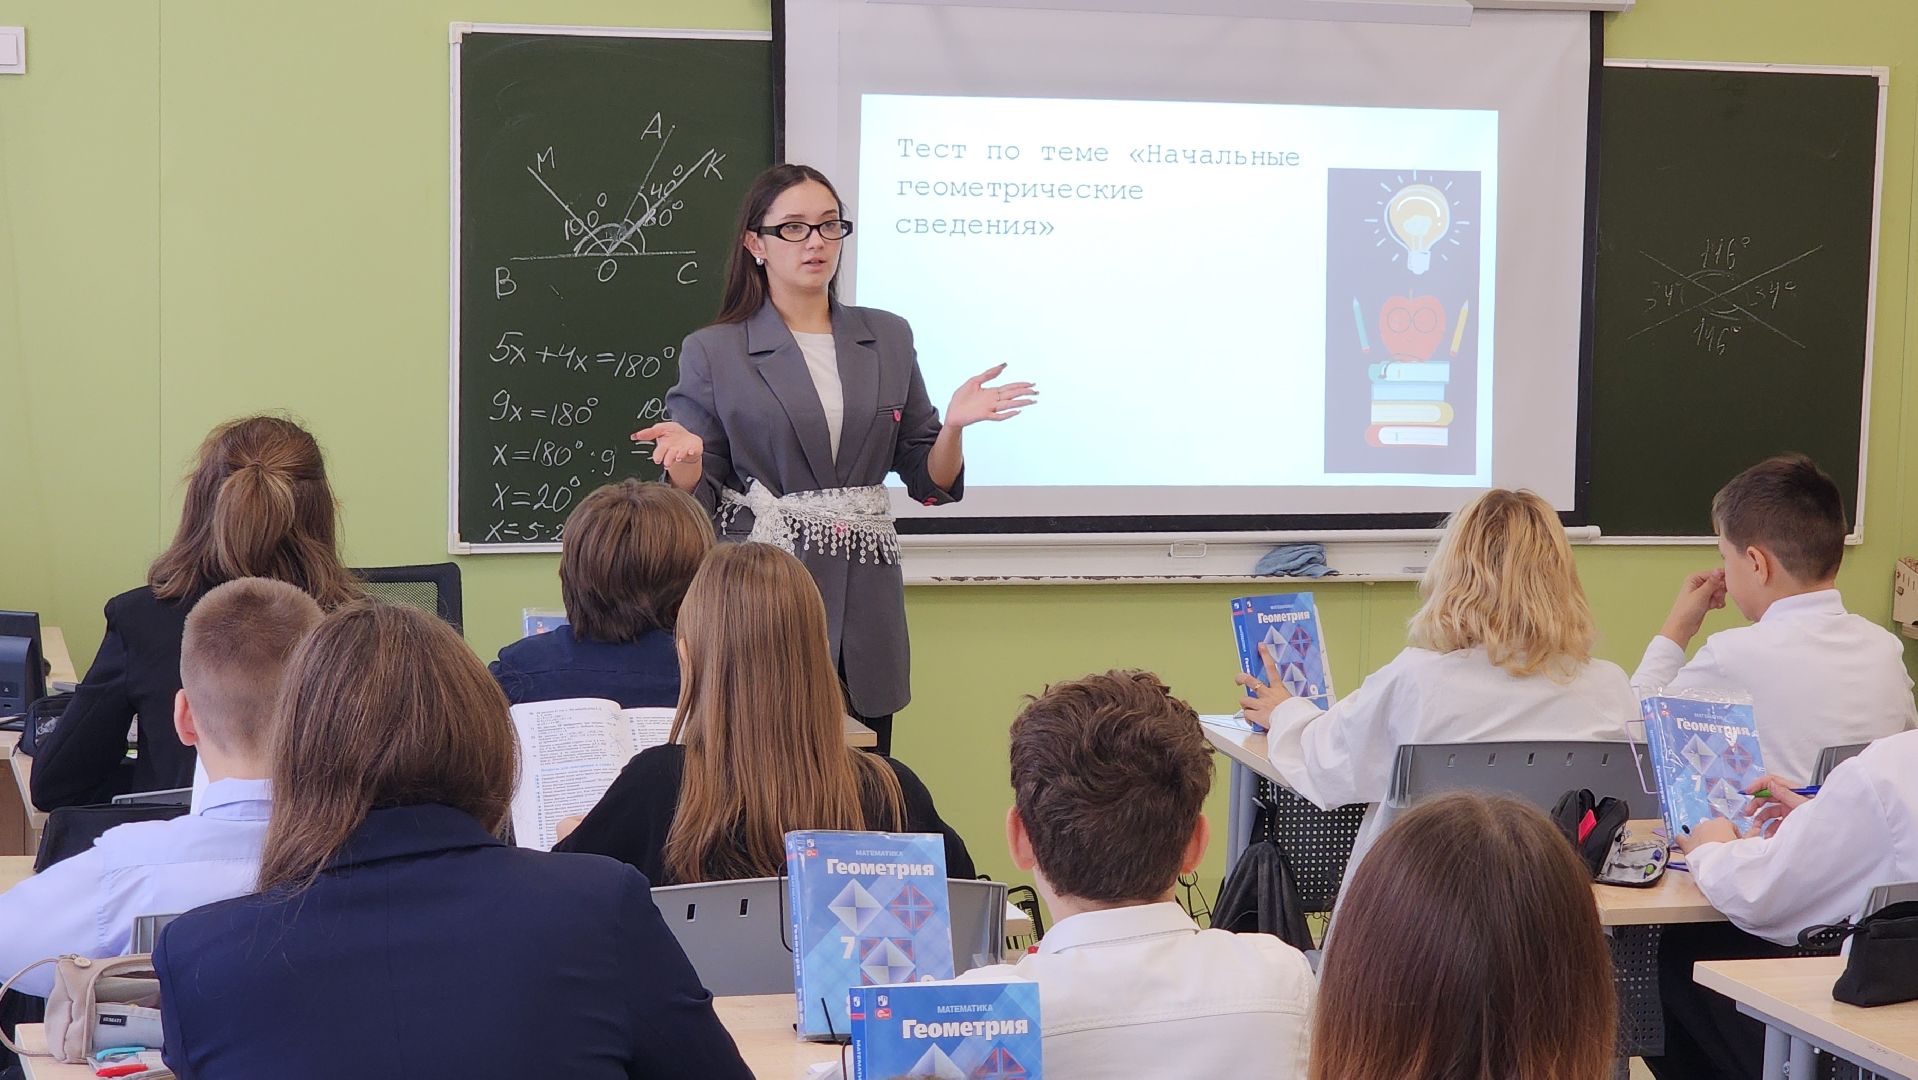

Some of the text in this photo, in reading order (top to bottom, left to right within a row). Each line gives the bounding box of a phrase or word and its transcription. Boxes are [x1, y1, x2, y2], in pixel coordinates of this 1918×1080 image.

[640, 111, 662, 140] A
[536, 146, 556, 172] M
[897, 138, 1300, 167] Тест по теме «Начальные
[896, 178, 1144, 203] геометрические
[895, 214, 1055, 237] сведения»
[495, 266, 517, 300] B
[1257, 610, 1311, 624] Геометрия
[855, 849, 904, 857] МАТЕМАТИКА
[826, 858, 935, 880] Геометрия
[840, 936, 856, 960] 7
[937, 1004, 993, 1014] МАТЕМАТИКА
[902, 1019, 1028, 1041] Геометрия
